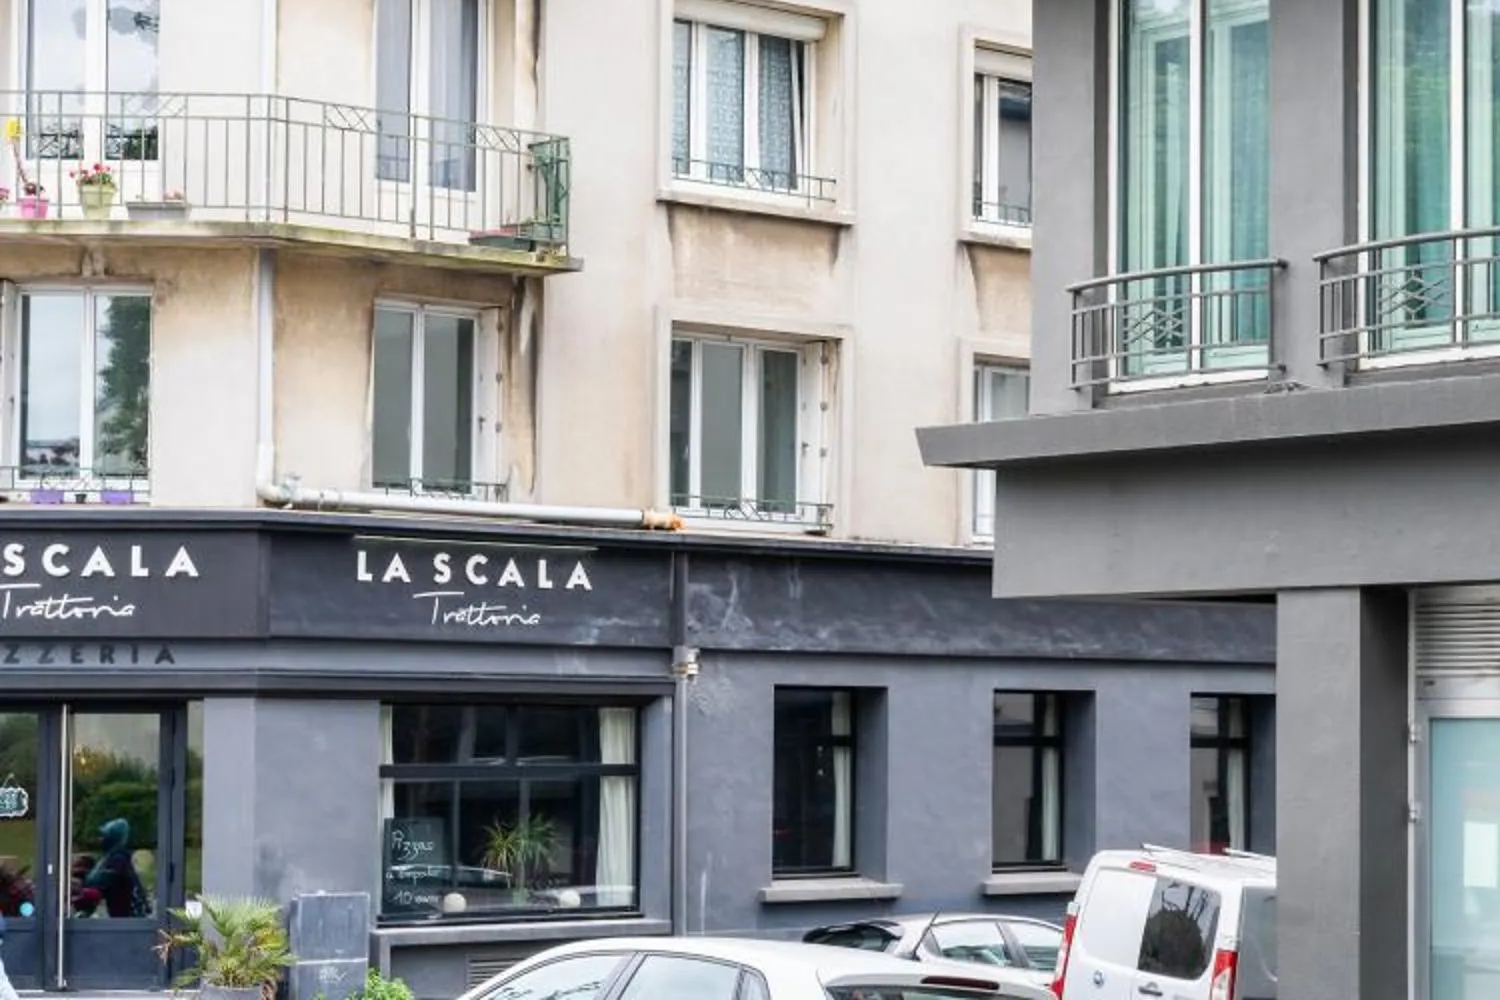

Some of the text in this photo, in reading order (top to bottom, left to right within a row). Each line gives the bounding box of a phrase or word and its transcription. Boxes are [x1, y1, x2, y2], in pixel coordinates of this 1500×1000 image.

[3, 543, 200, 577] SCALA
[357, 551, 593, 591] LA SCALA
[0, 583, 136, 620] Trattoria
[412, 591, 541, 625] Trattoria
